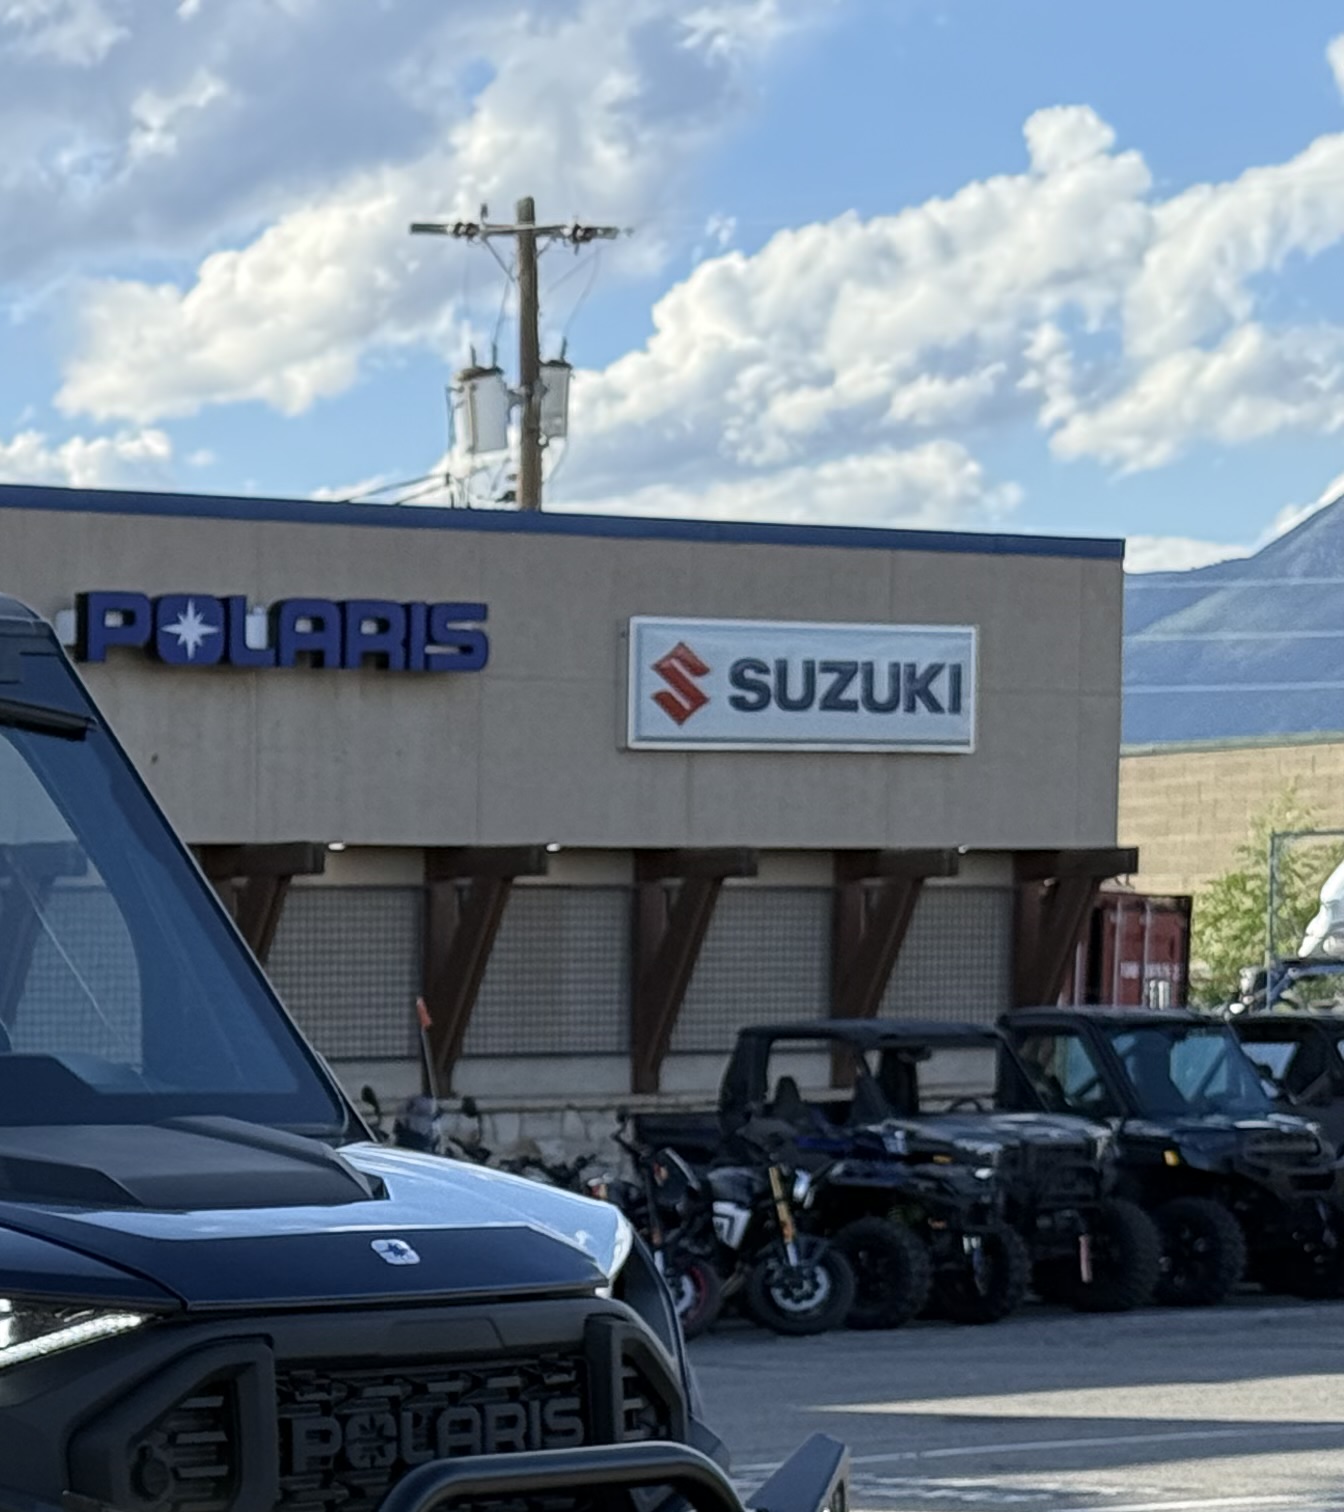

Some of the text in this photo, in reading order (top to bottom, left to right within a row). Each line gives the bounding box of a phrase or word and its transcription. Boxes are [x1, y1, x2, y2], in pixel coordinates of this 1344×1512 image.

[81, 591, 489, 672] POLARIS
[727, 657, 963, 714] SUZUKI
[292, 1398, 585, 1473] POLARIS
